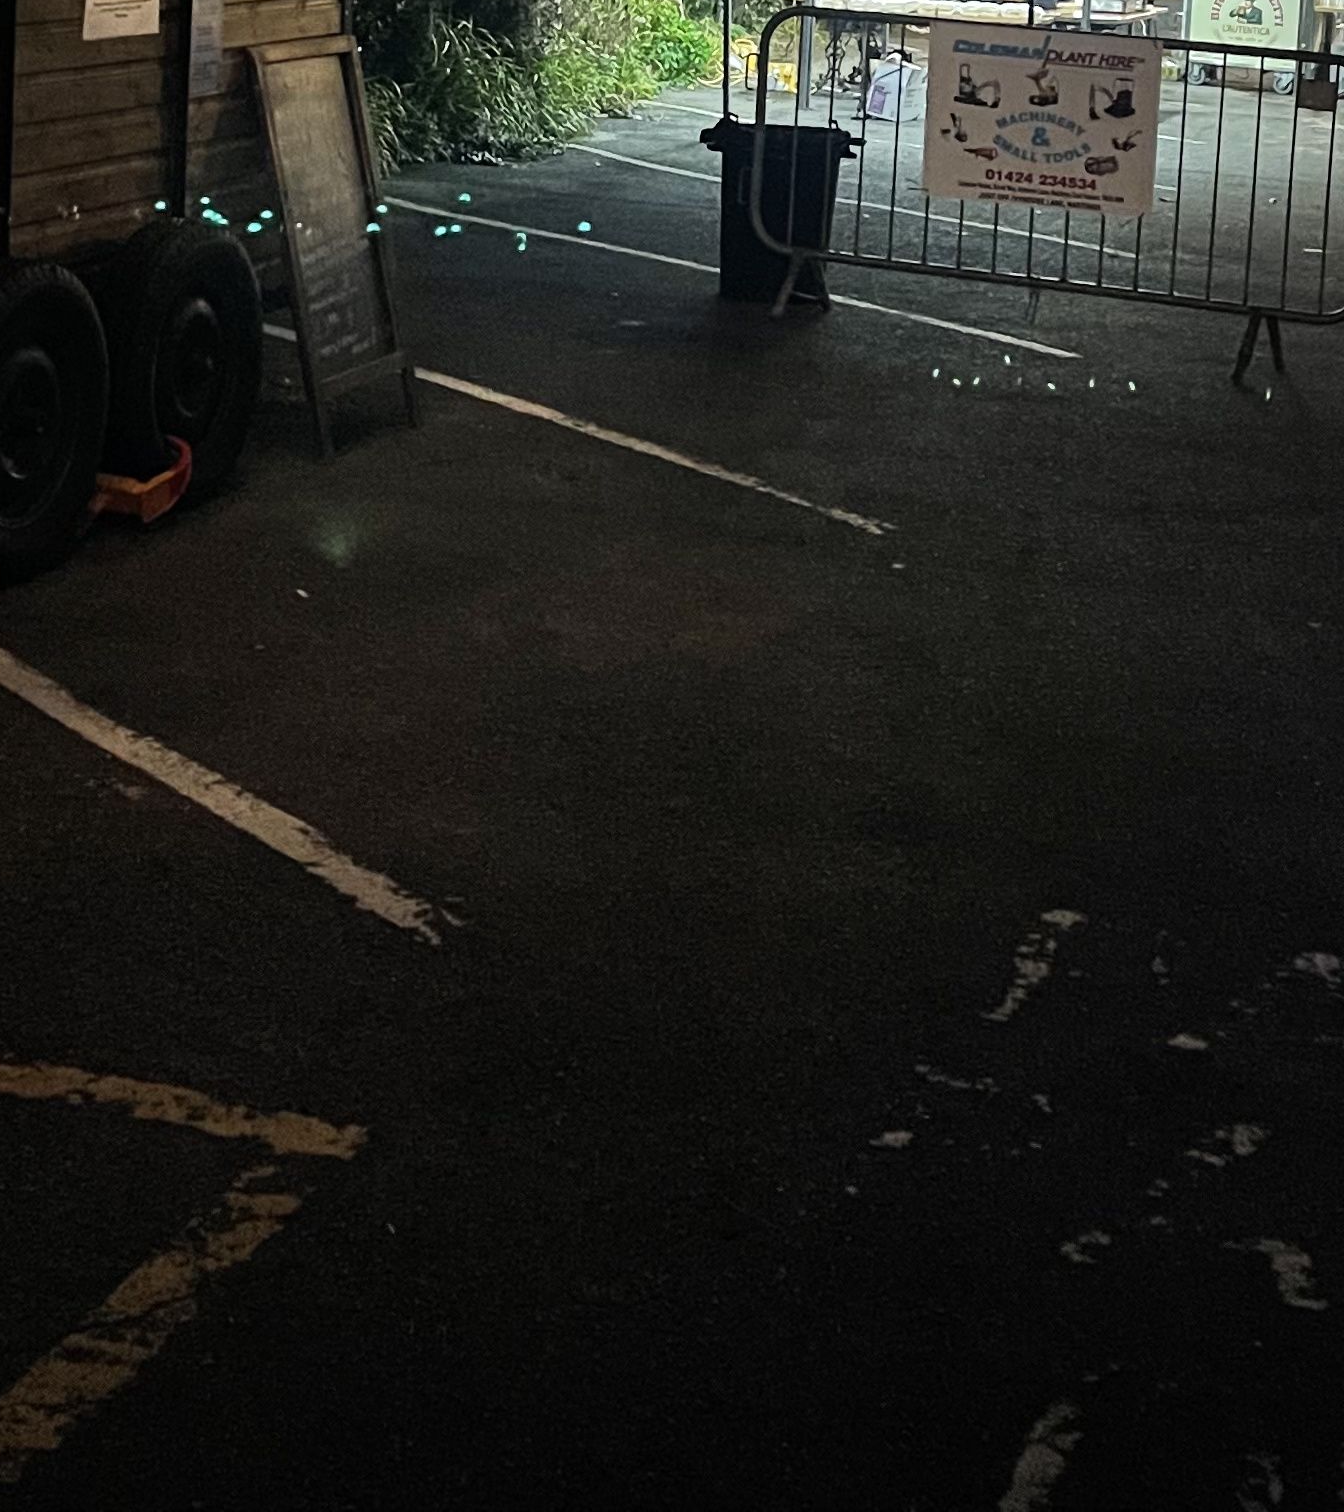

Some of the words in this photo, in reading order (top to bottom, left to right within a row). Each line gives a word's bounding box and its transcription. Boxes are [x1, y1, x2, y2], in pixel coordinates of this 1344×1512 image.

[1044, 50, 1094, 67] PLANT
[1098, 54, 1136, 69] HIRE
[996, 111, 1086, 136] MACHINERY
[1031, 127, 1050, 146] &
[993, 135, 1038, 163] SMALL
[1043, 143, 1091, 164] TOOLS
[985, 169, 1033, 183] 01424
[1039, 174, 1097, 190] 234534
